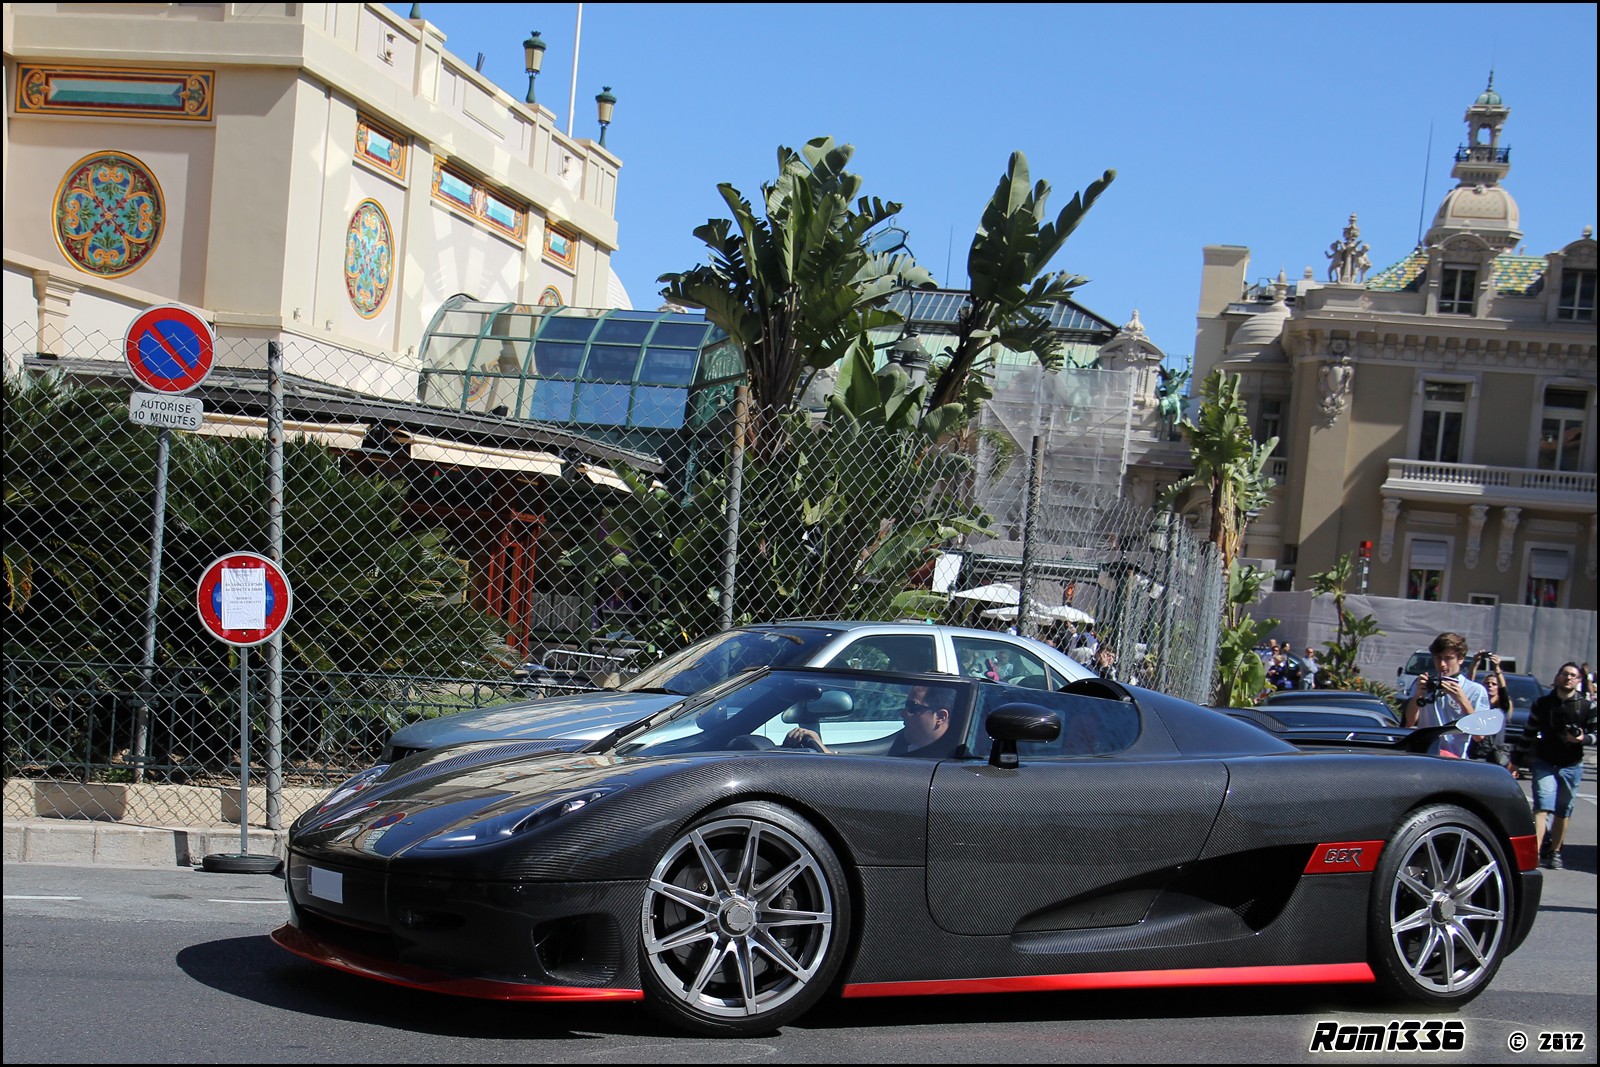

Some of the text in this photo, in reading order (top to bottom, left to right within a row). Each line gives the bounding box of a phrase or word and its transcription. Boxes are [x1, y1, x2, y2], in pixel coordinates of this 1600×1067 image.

[140, 400, 192, 414] AUTORISE
[133, 411, 196, 426] 10 MINUTES
[1324, 848, 1363, 867] CCR
